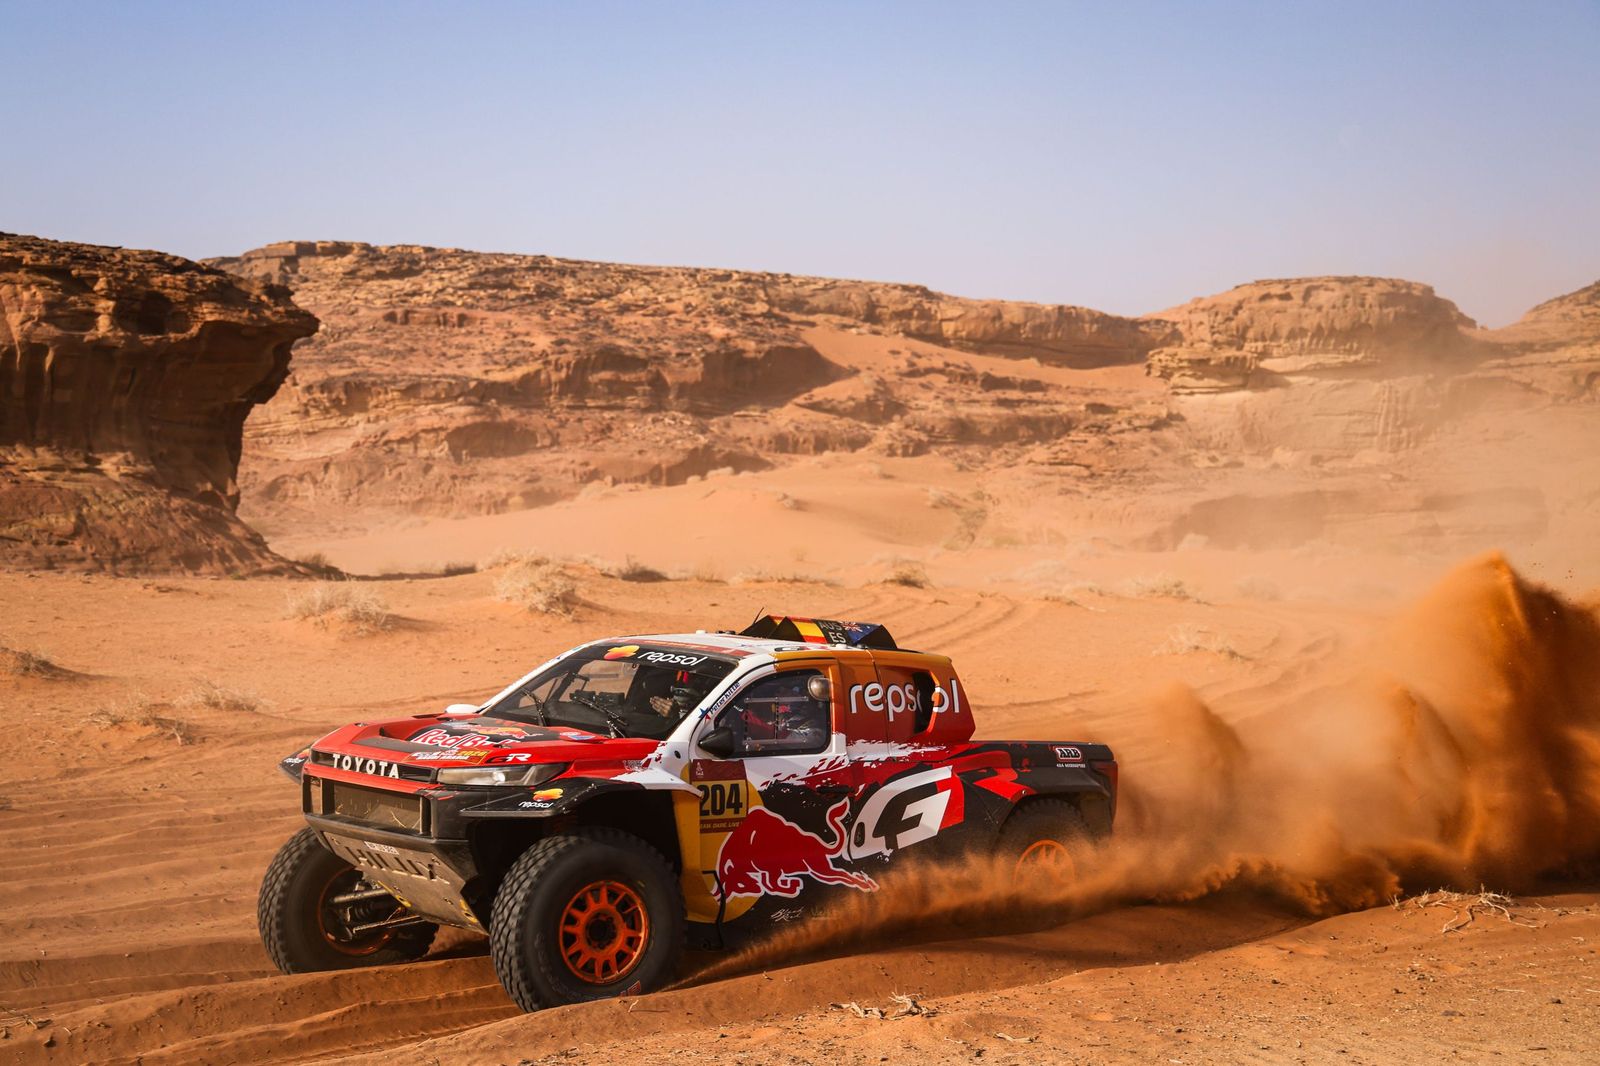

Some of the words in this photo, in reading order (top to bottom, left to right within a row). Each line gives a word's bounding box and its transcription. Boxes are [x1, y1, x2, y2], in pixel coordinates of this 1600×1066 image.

[819, 620, 843, 631] AUS
[828, 631, 847, 644] ES
[637, 651, 708, 666] repsol
[850, 680, 959, 721] repsol
[411, 729, 471, 748] Red
[486, 753, 532, 764] GR
[1056, 748, 1081, 759] ARB
[333, 753, 400, 779] TOYOTA
[518, 800, 555, 812] repsol
[698, 784, 742, 816] 204
